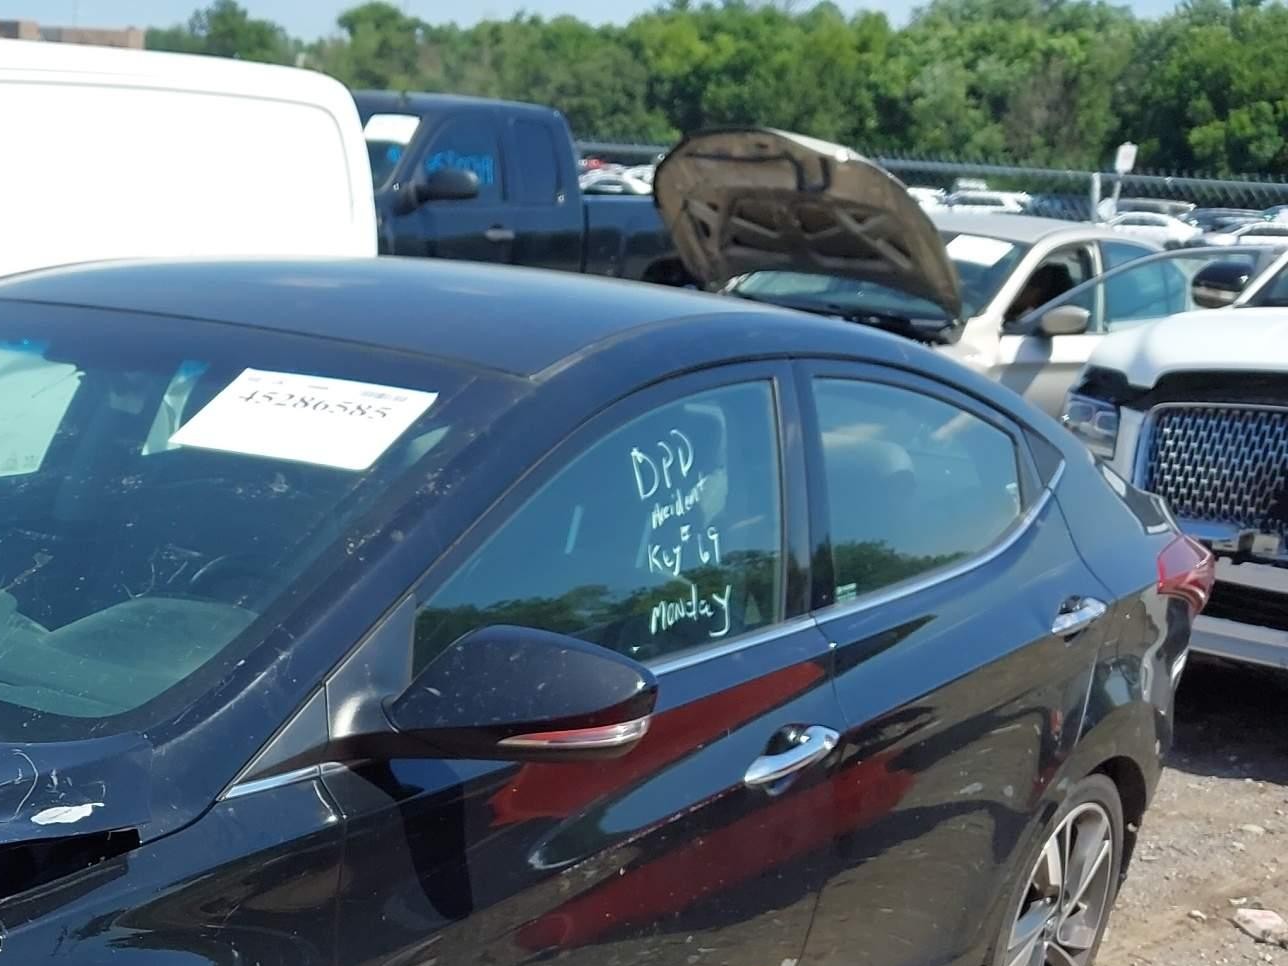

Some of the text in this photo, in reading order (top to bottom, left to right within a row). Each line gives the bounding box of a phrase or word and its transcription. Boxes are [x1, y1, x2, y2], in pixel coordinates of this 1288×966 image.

[239, 390, 392, 419] 45286585
[630, 429, 694, 500] DPD
[648, 544, 682, 577] Key
[651, 583, 732, 637] Monday
